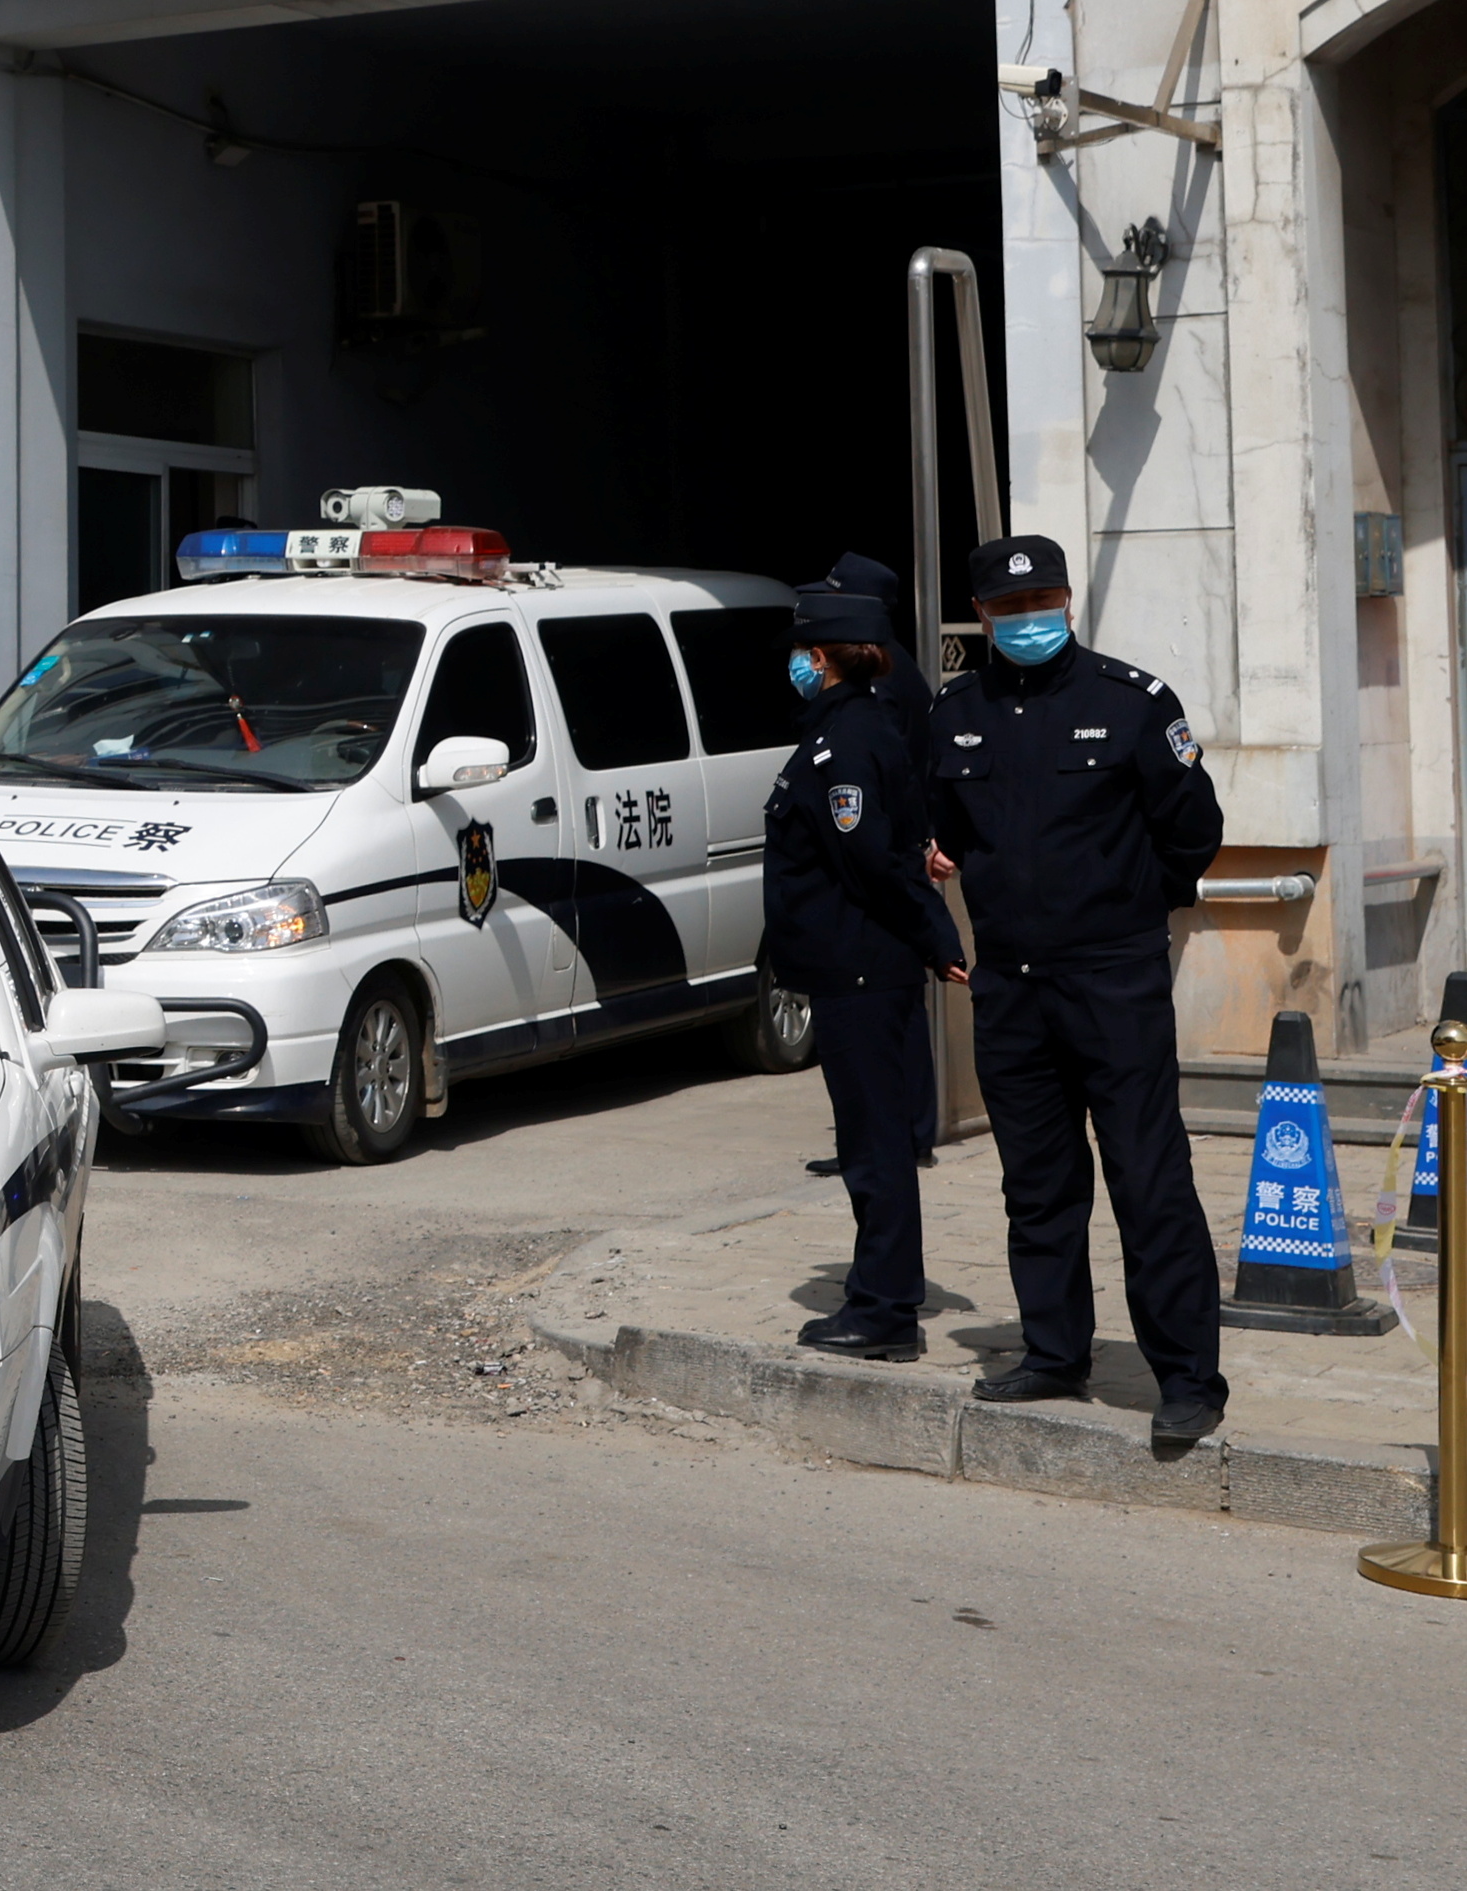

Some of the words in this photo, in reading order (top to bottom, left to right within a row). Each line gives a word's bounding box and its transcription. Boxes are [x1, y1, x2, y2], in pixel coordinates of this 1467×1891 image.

[299, 535, 350, 555] 警察
[614, 787, 674, 851] 法院
[122, 821, 193, 852] 察
[1254, 1180, 1322, 1216] 警察
[1254, 1210, 1320, 1232] POLICE
